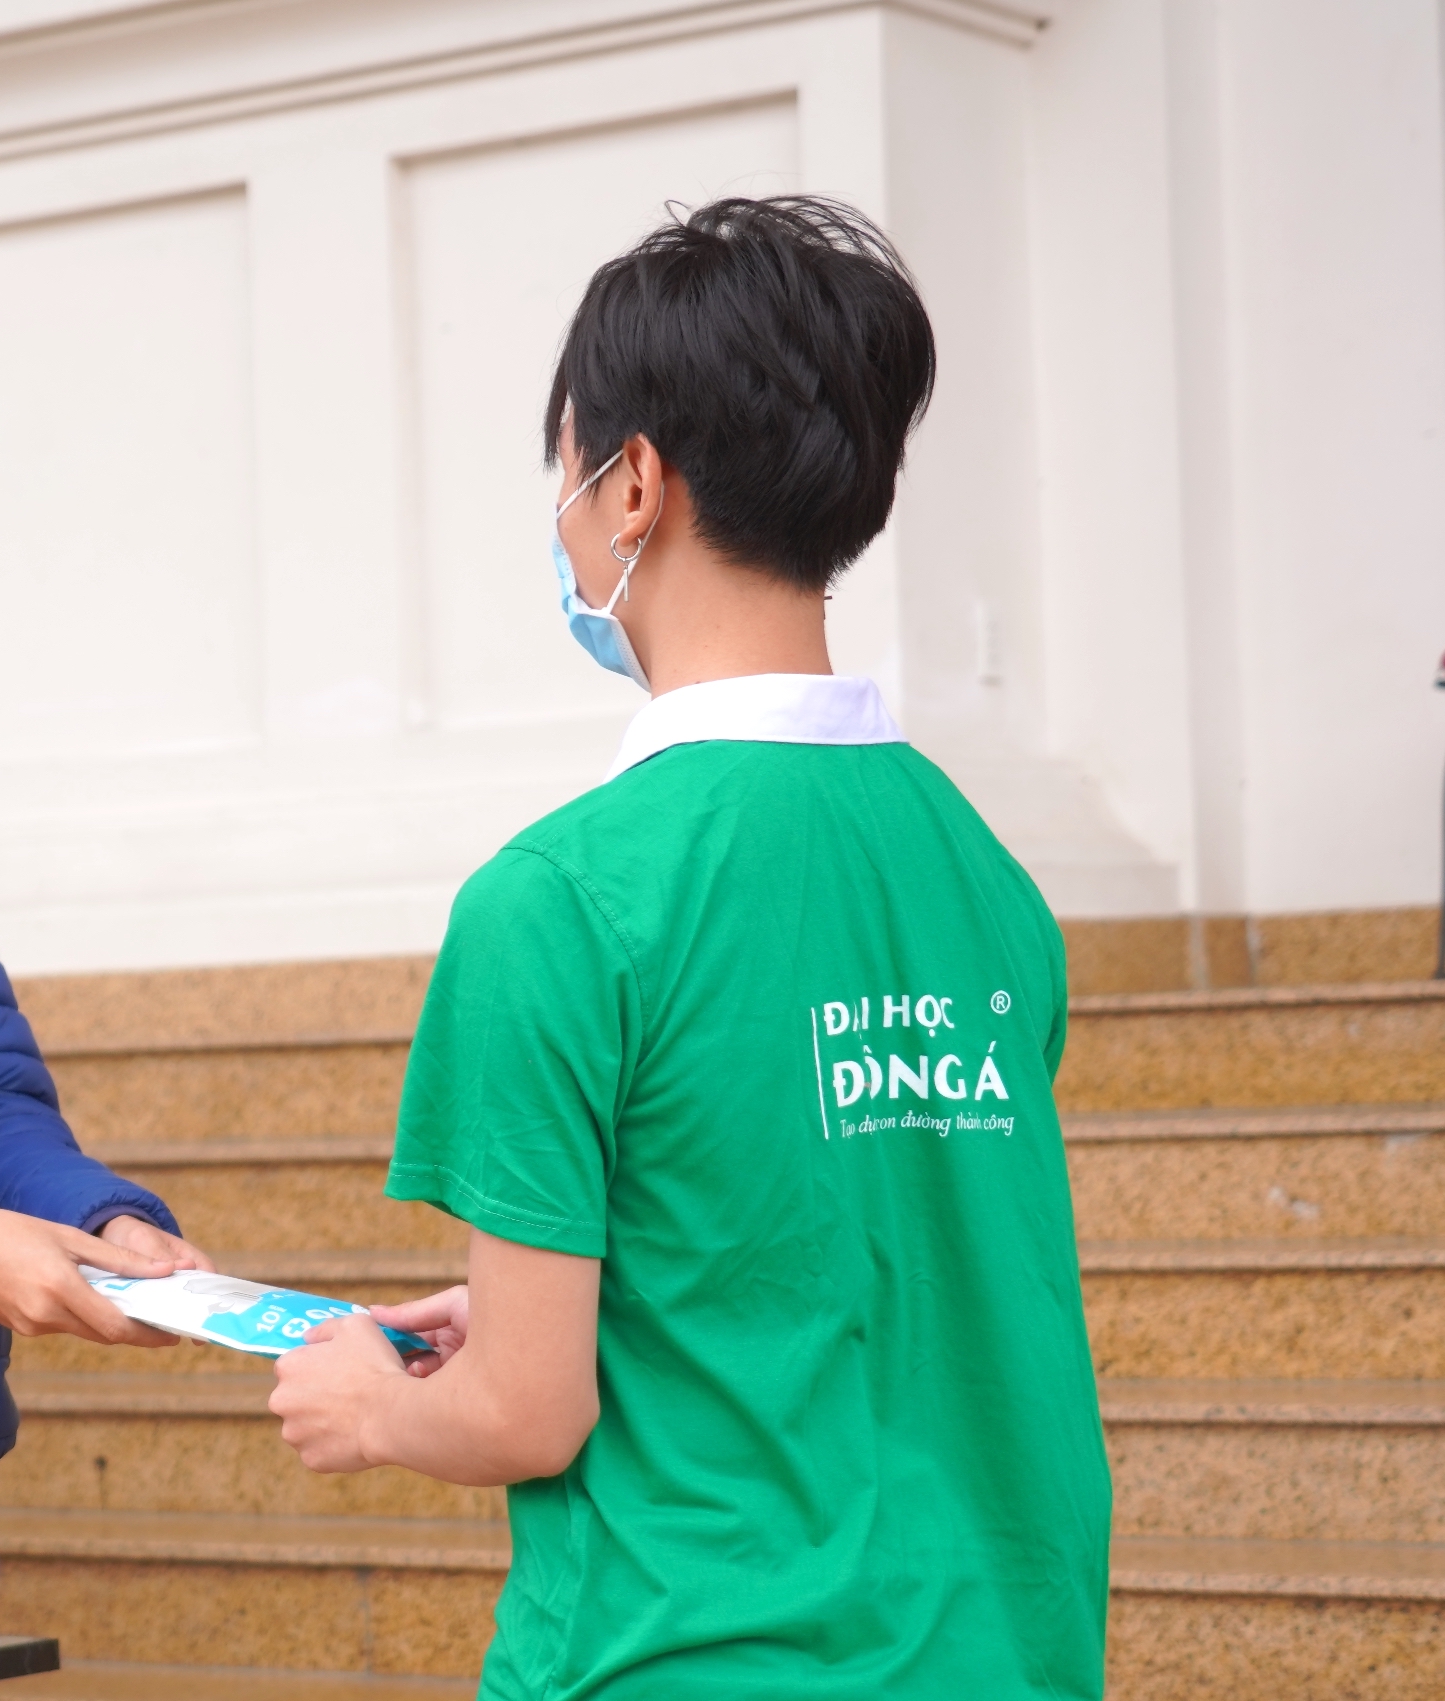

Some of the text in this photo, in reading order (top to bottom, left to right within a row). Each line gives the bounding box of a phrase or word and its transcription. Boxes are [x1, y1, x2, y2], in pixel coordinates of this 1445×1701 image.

[882, 994, 955, 1037] HỌC
[975, 1040, 1009, 1101] Á
[901, 1110, 951, 1138] đường
[983, 1115, 1014, 1137] công
